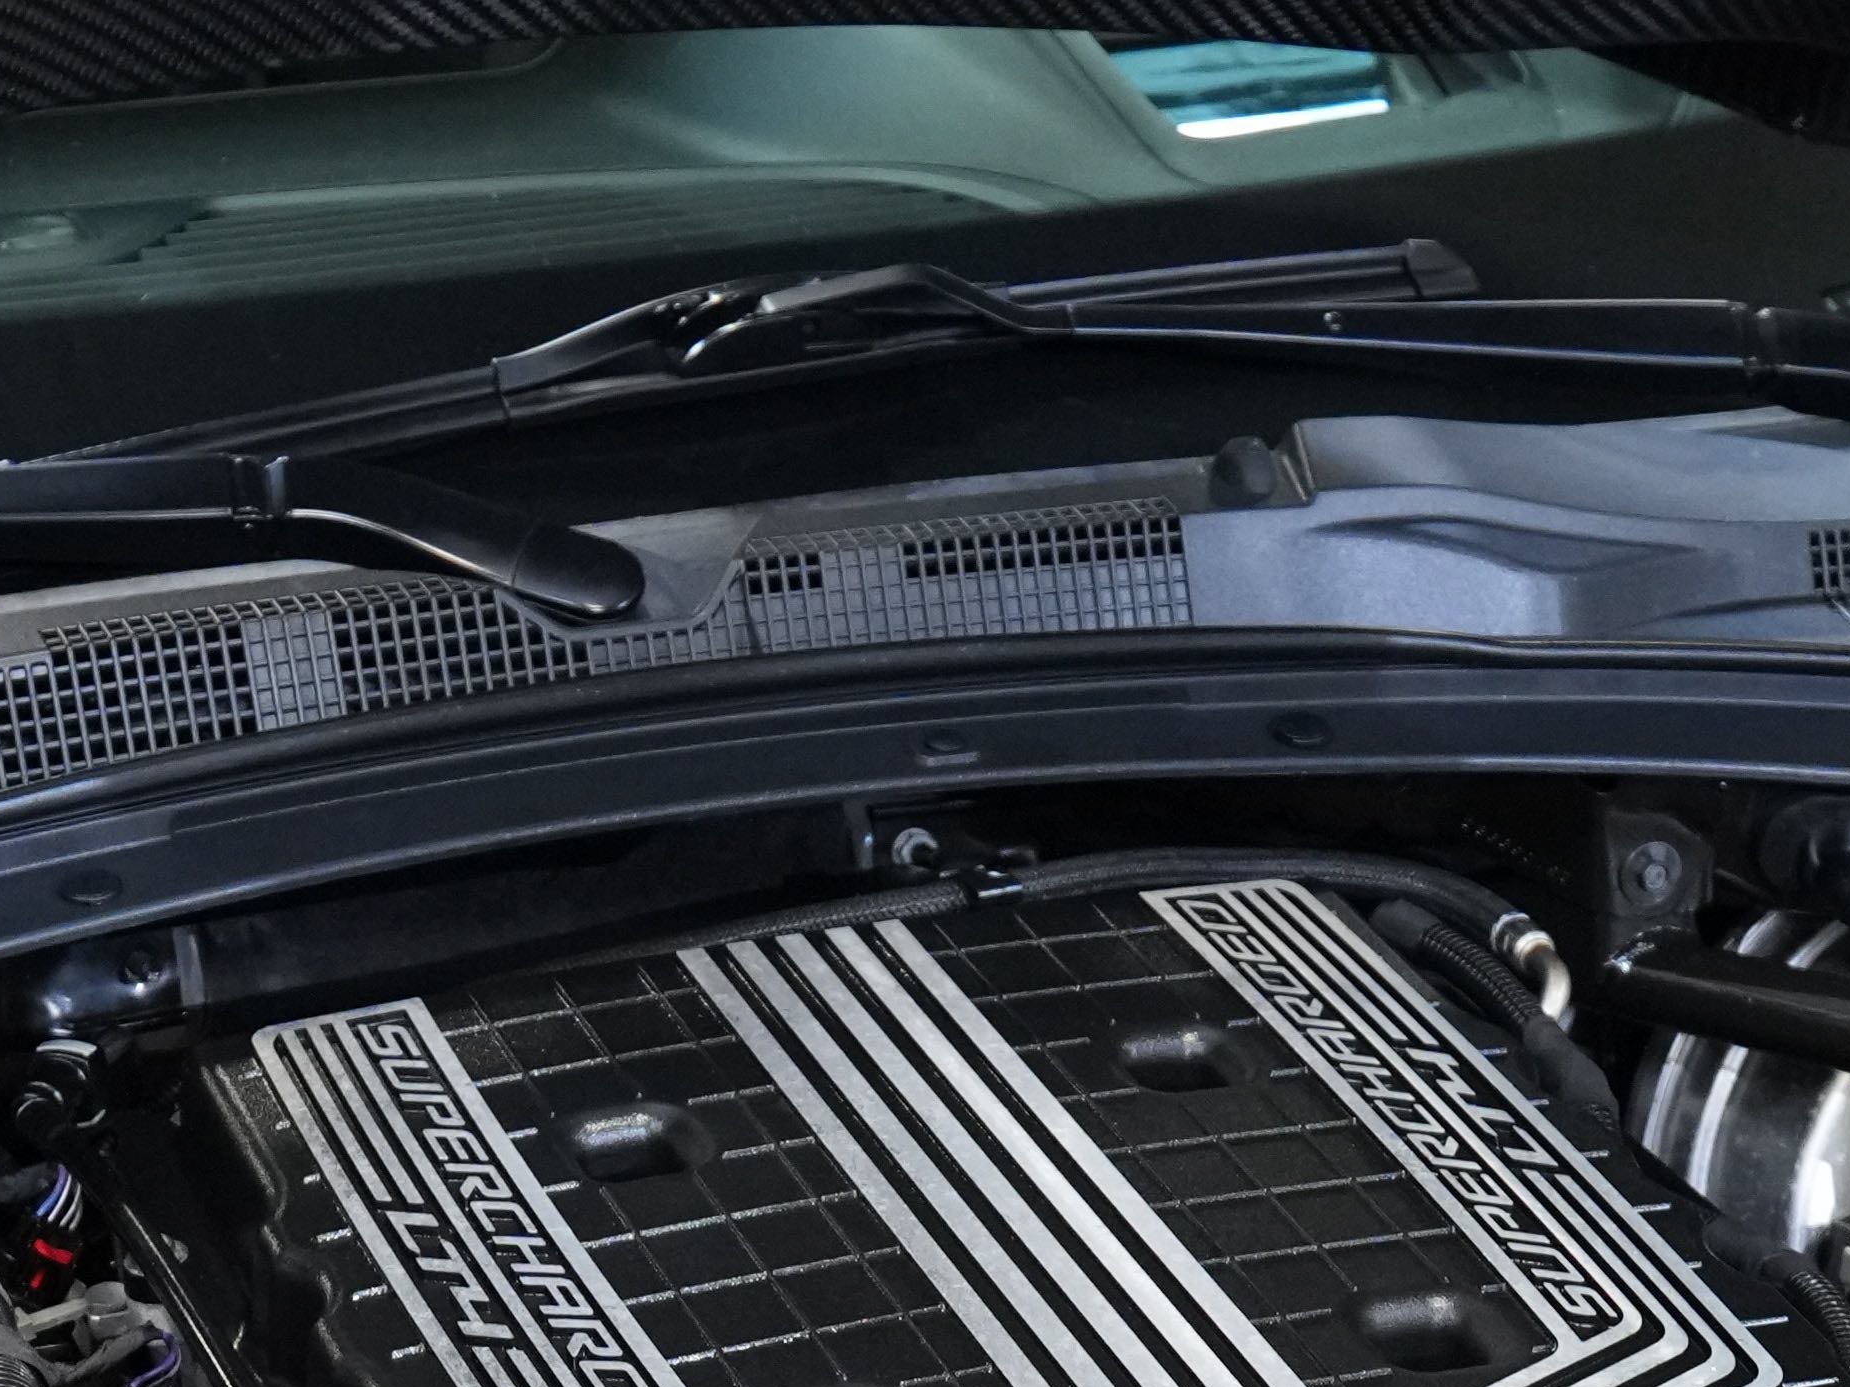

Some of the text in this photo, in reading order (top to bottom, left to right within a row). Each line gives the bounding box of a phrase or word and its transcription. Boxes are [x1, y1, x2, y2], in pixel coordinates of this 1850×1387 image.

[1183, 899, 1620, 1328] SUPERCHARGED
[1409, 1047, 1560, 1169] LT4
[387, 1211, 514, 1341] LT4
